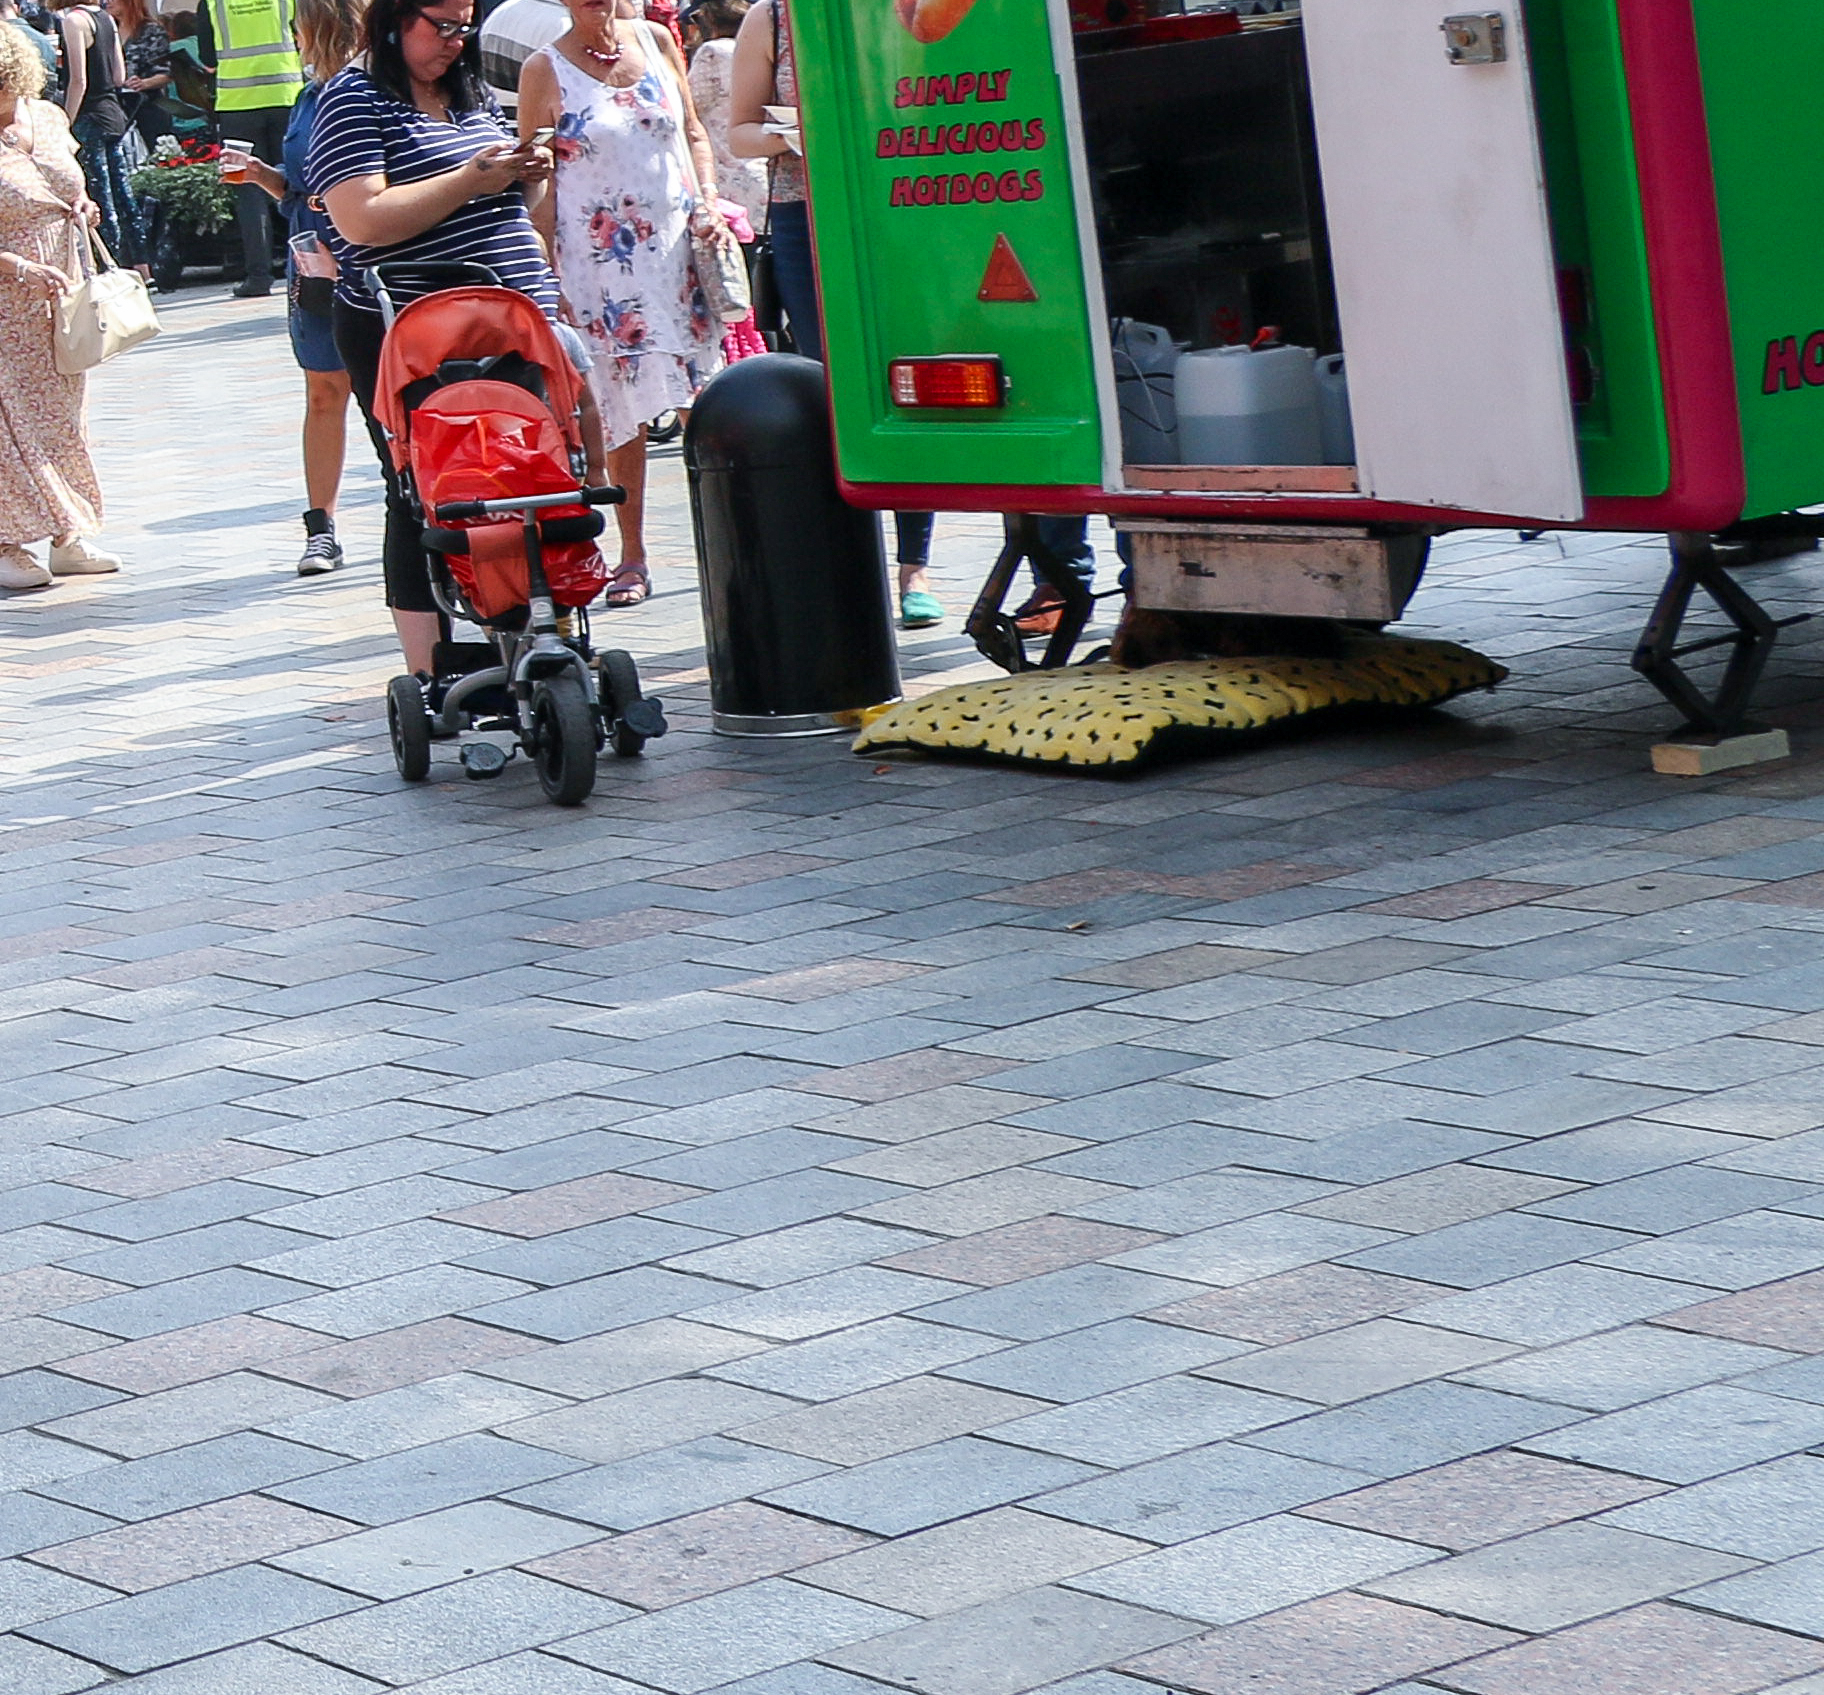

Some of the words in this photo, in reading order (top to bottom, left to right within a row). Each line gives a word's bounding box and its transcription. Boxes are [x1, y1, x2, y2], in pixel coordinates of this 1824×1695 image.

[894, 69, 1012, 108] SIMPLY
[876, 119, 1047, 158] DELICIOUS
[890, 170, 1044, 206] HOTDOGS
